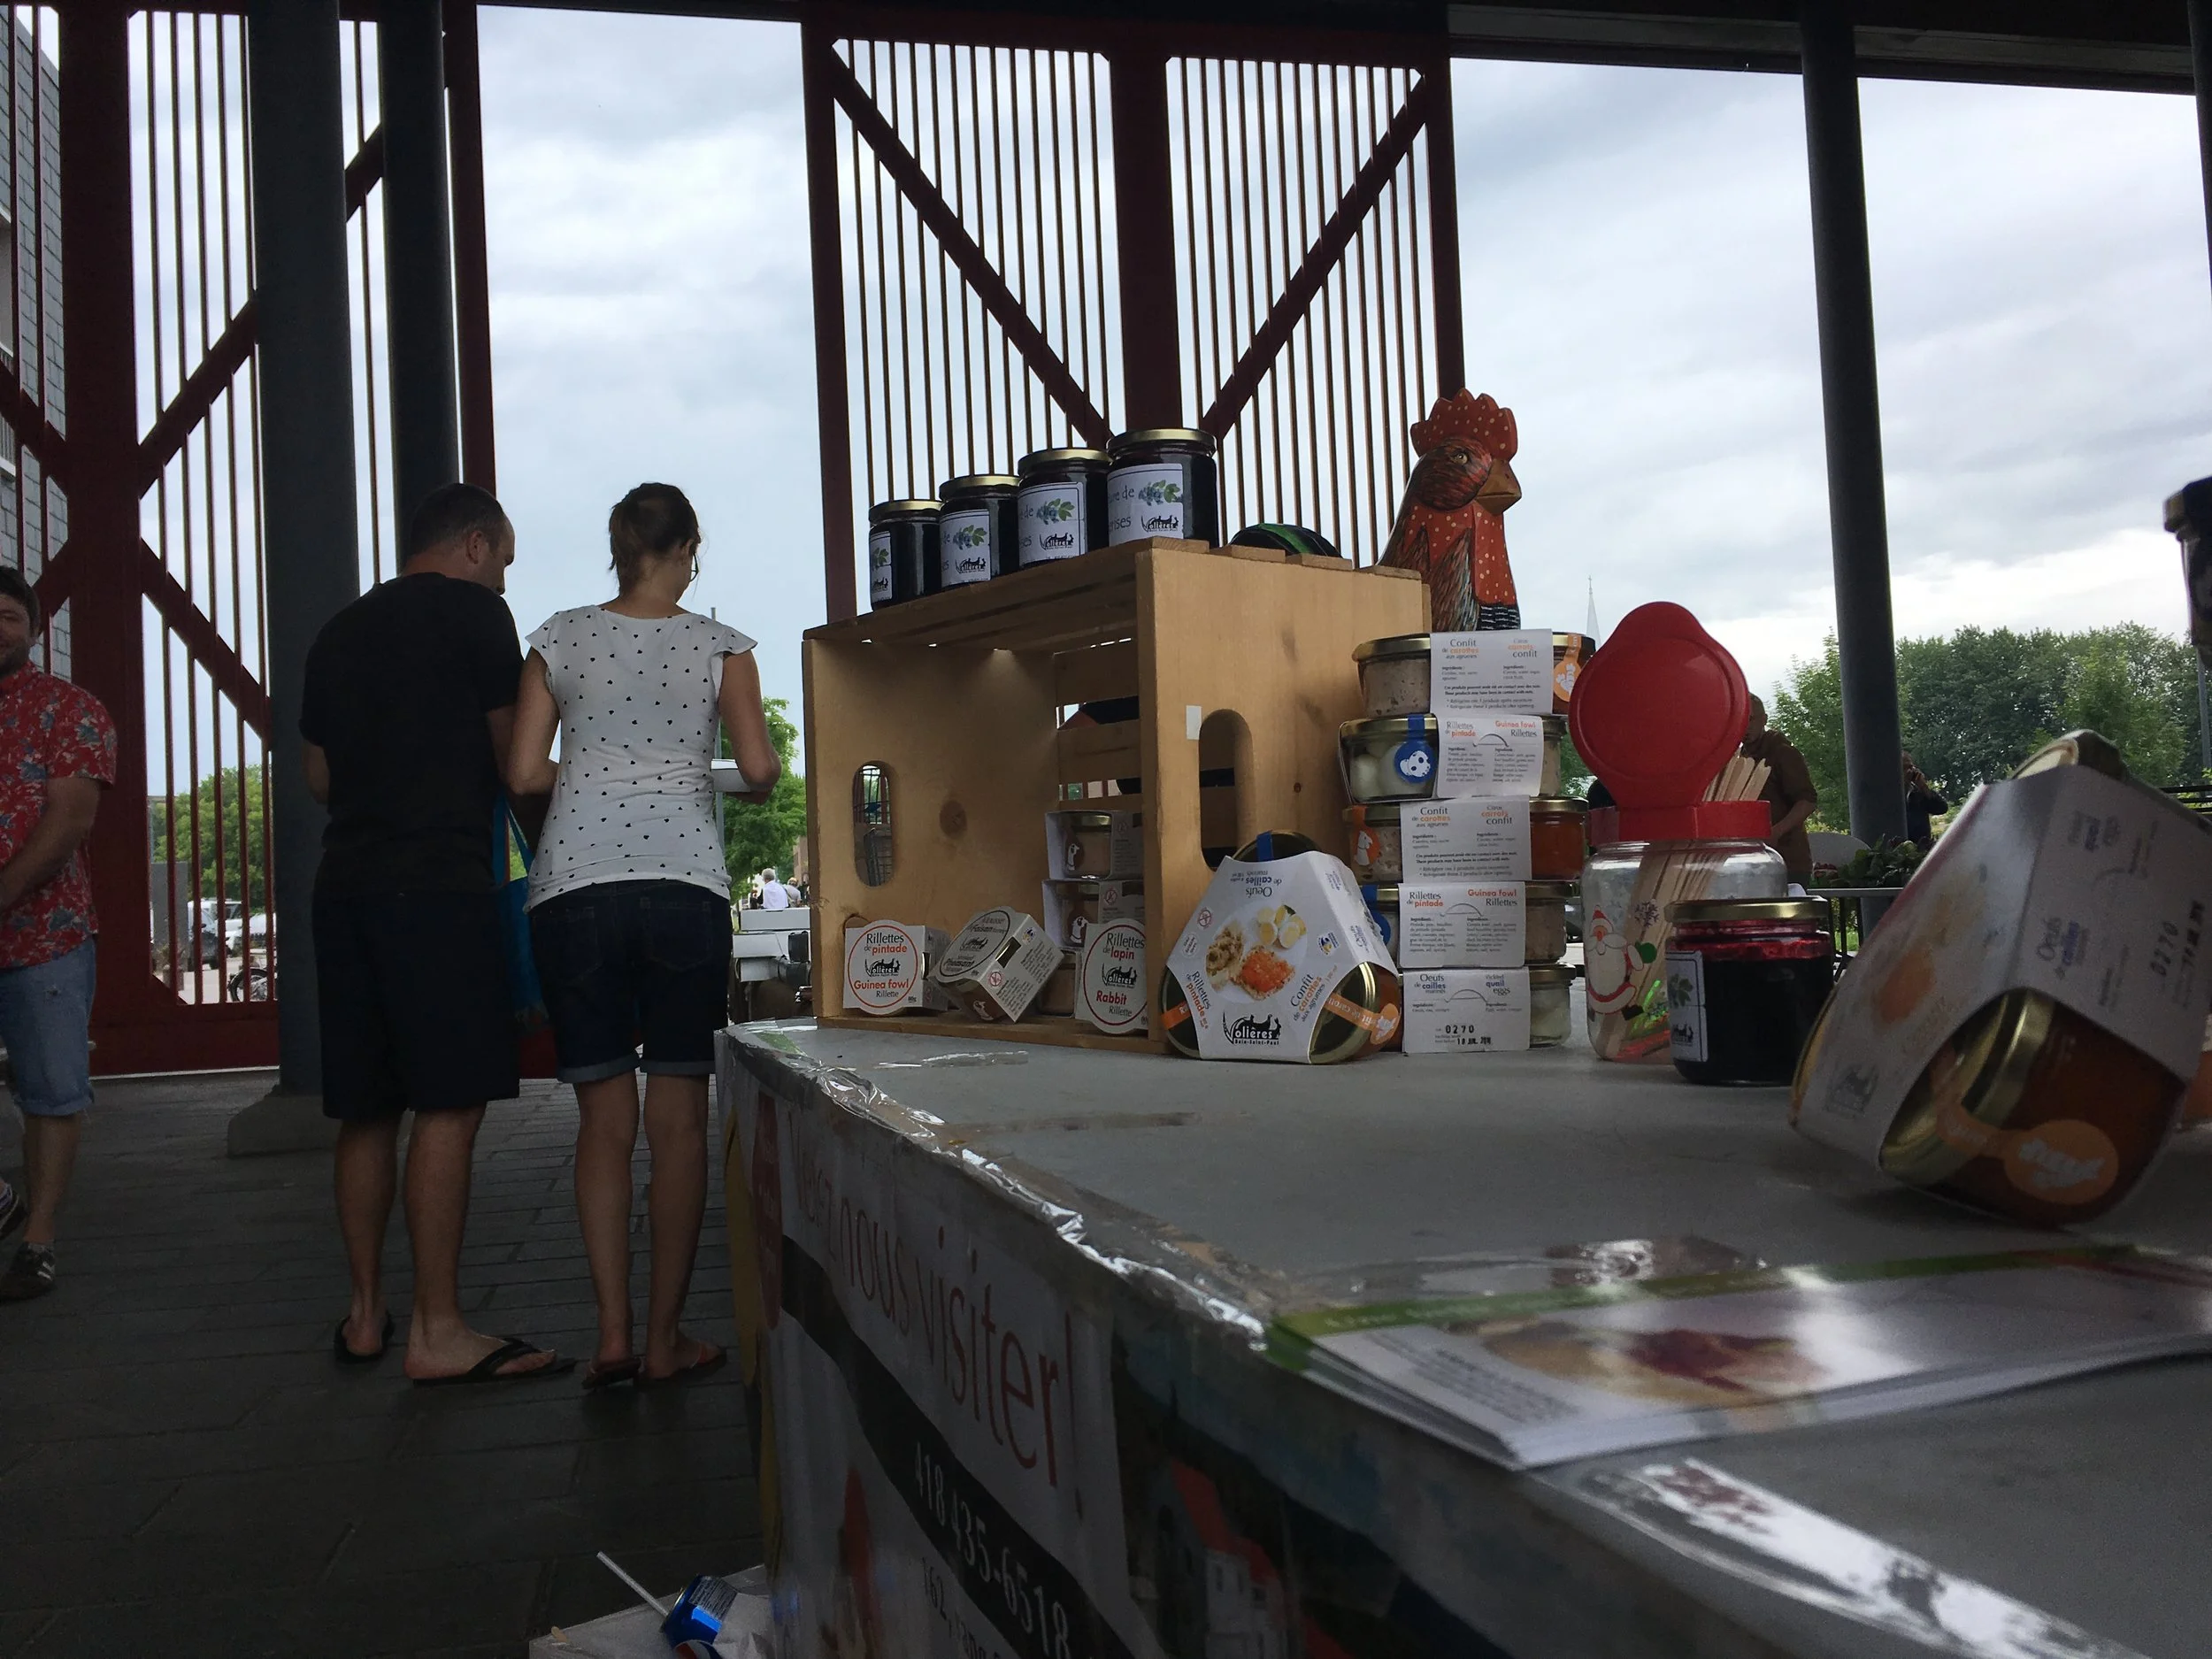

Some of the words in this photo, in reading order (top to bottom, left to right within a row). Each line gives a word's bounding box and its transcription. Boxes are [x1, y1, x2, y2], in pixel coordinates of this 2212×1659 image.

[1122, 485, 1134, 499] de
[1450, 638, 1477, 647] Confit
[1513, 649, 1537, 658] confit
[1451, 730, 1476, 739] pintade
[1246, 877, 1272, 886] cailles
[1245, 887, 1272, 898] Oeufs
[1409, 891, 1441, 900] Rillettes
[866, 933, 904, 944] Rillettes
[1106, 933, 1145, 949] Rillettes
[872, 944, 908, 956] pintade
[1110, 946, 1134, 961] lapin
[854, 979, 886, 989] Guinea
[888, 979, 909, 988] fowl
[1192, 971, 1211, 1010] Rillettes
[1290, 974, 1314, 1007] Confit
[1096, 990, 1127, 1005] Rabbit
[1186, 983, 1205, 1018] pintade
[1299, 976, 1322, 1012] carottes
[1310, 984, 1325, 1010] agrumes
[1109, 1006, 1133, 1017] Rillette
[839, 1196, 913, 1339] nous
[914, 1440, 946, 1528] 418
[950, 1489, 1073, 1659] 435-6518
